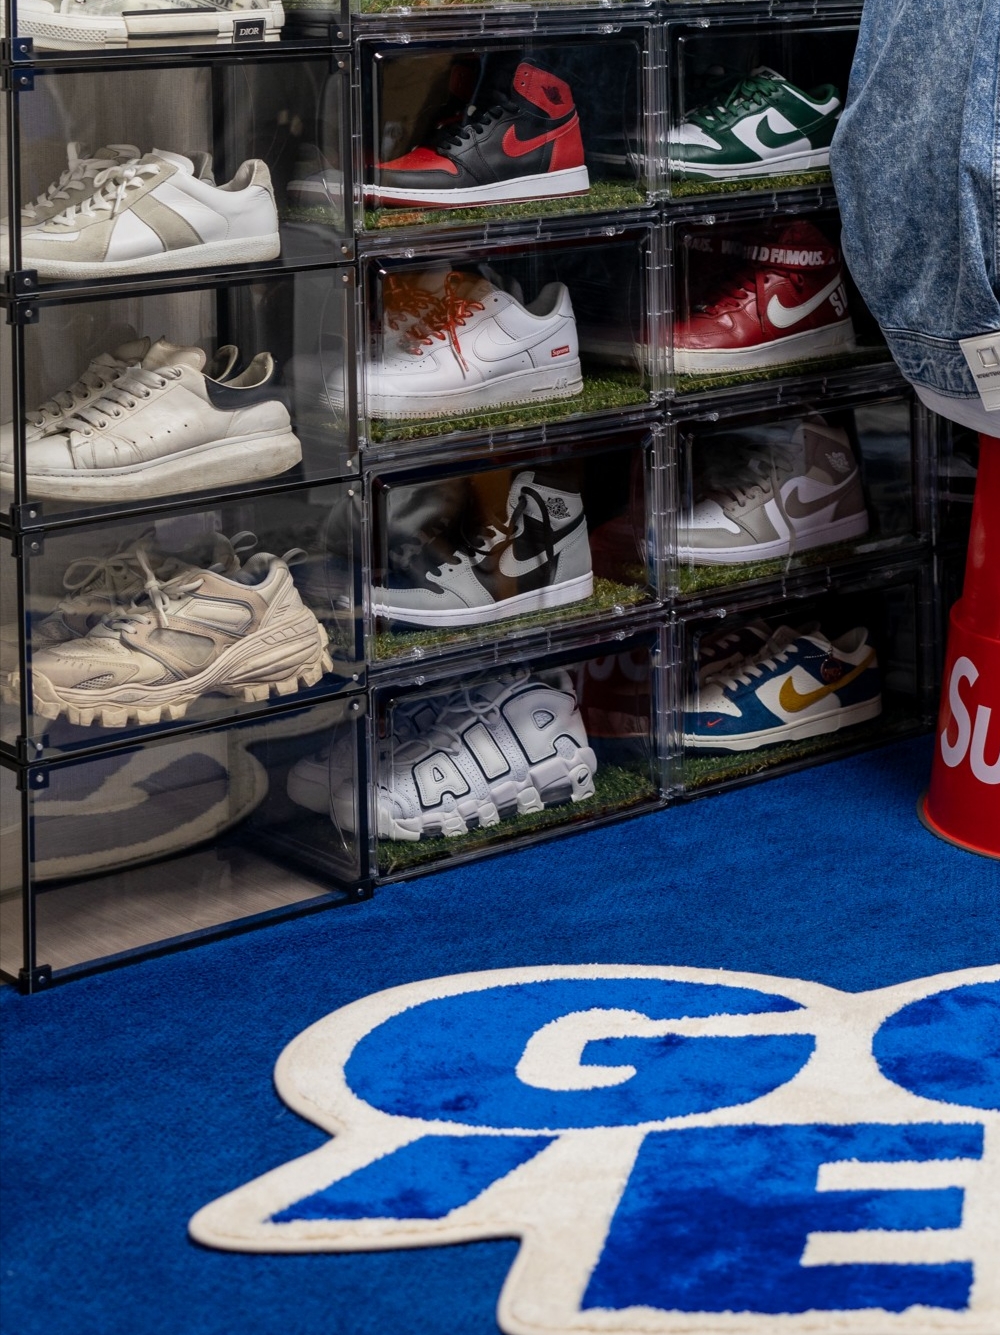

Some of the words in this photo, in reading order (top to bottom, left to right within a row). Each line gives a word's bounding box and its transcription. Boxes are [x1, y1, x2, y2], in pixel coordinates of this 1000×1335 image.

[239, 26, 260, 36] DIOR
[769, 248, 824, 266] FAMOUS.
[411, 686, 584, 808] AIR
